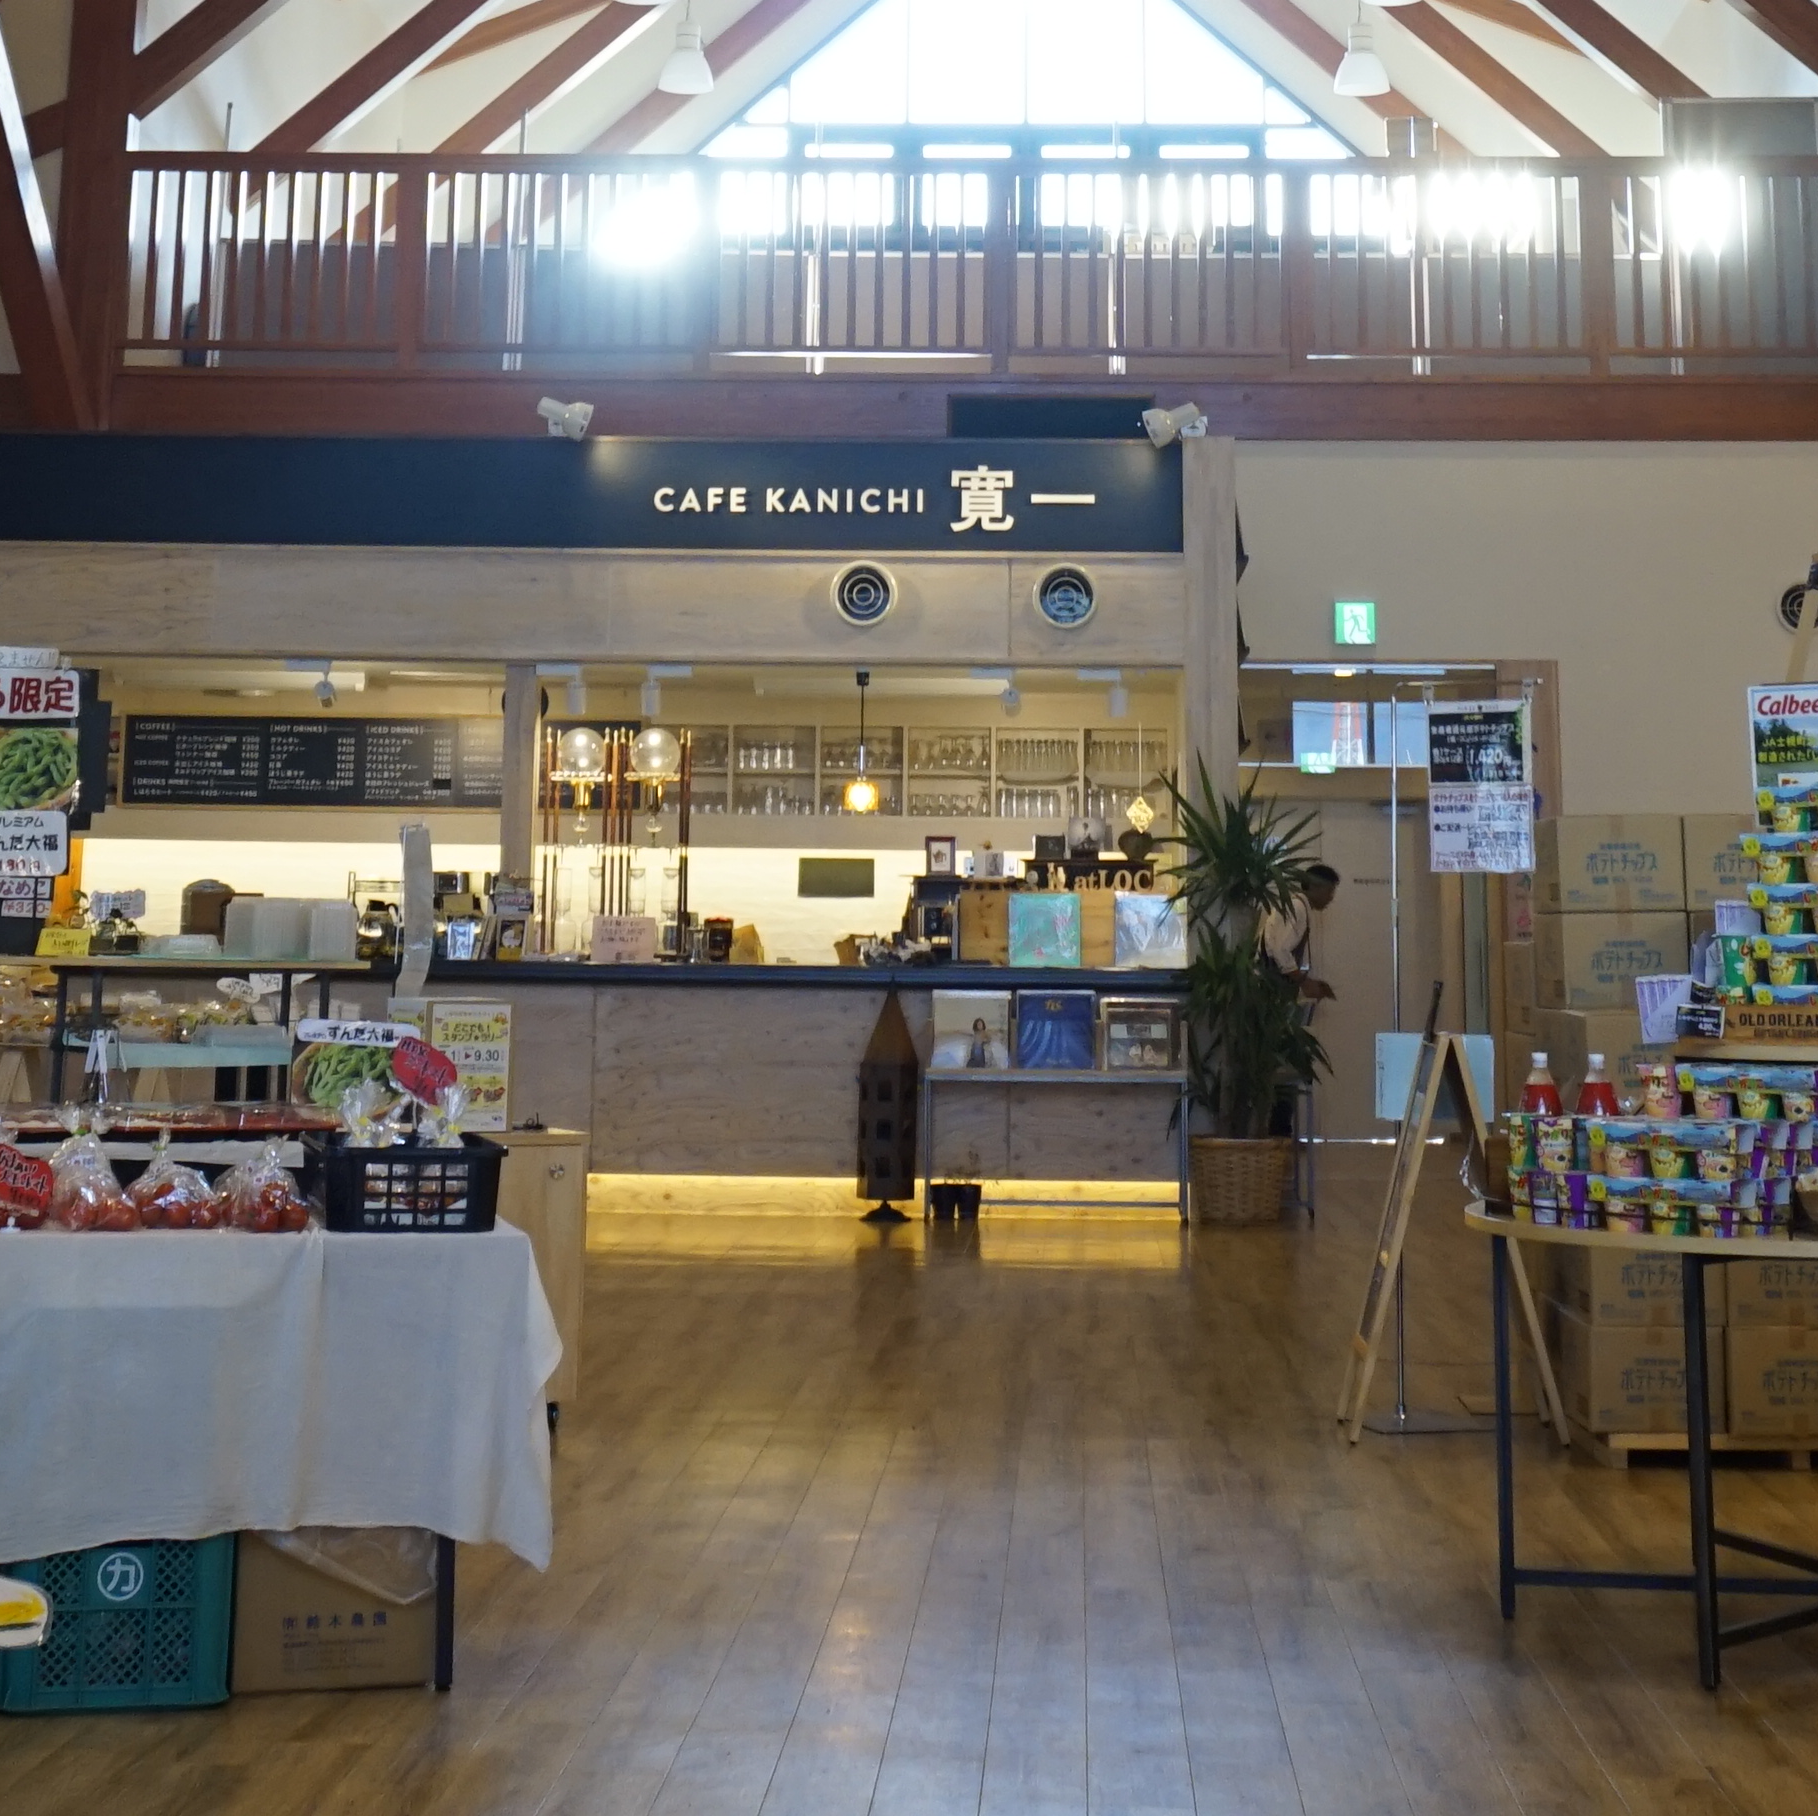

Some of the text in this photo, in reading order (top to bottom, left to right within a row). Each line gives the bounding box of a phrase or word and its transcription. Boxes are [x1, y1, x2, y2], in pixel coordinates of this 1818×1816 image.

[653, 465, 1096, 533] CAFE KANICHI 寛一
[1739, 1013, 1765, 1027] OLD
[474, 1049, 500, 1061] 9.30
